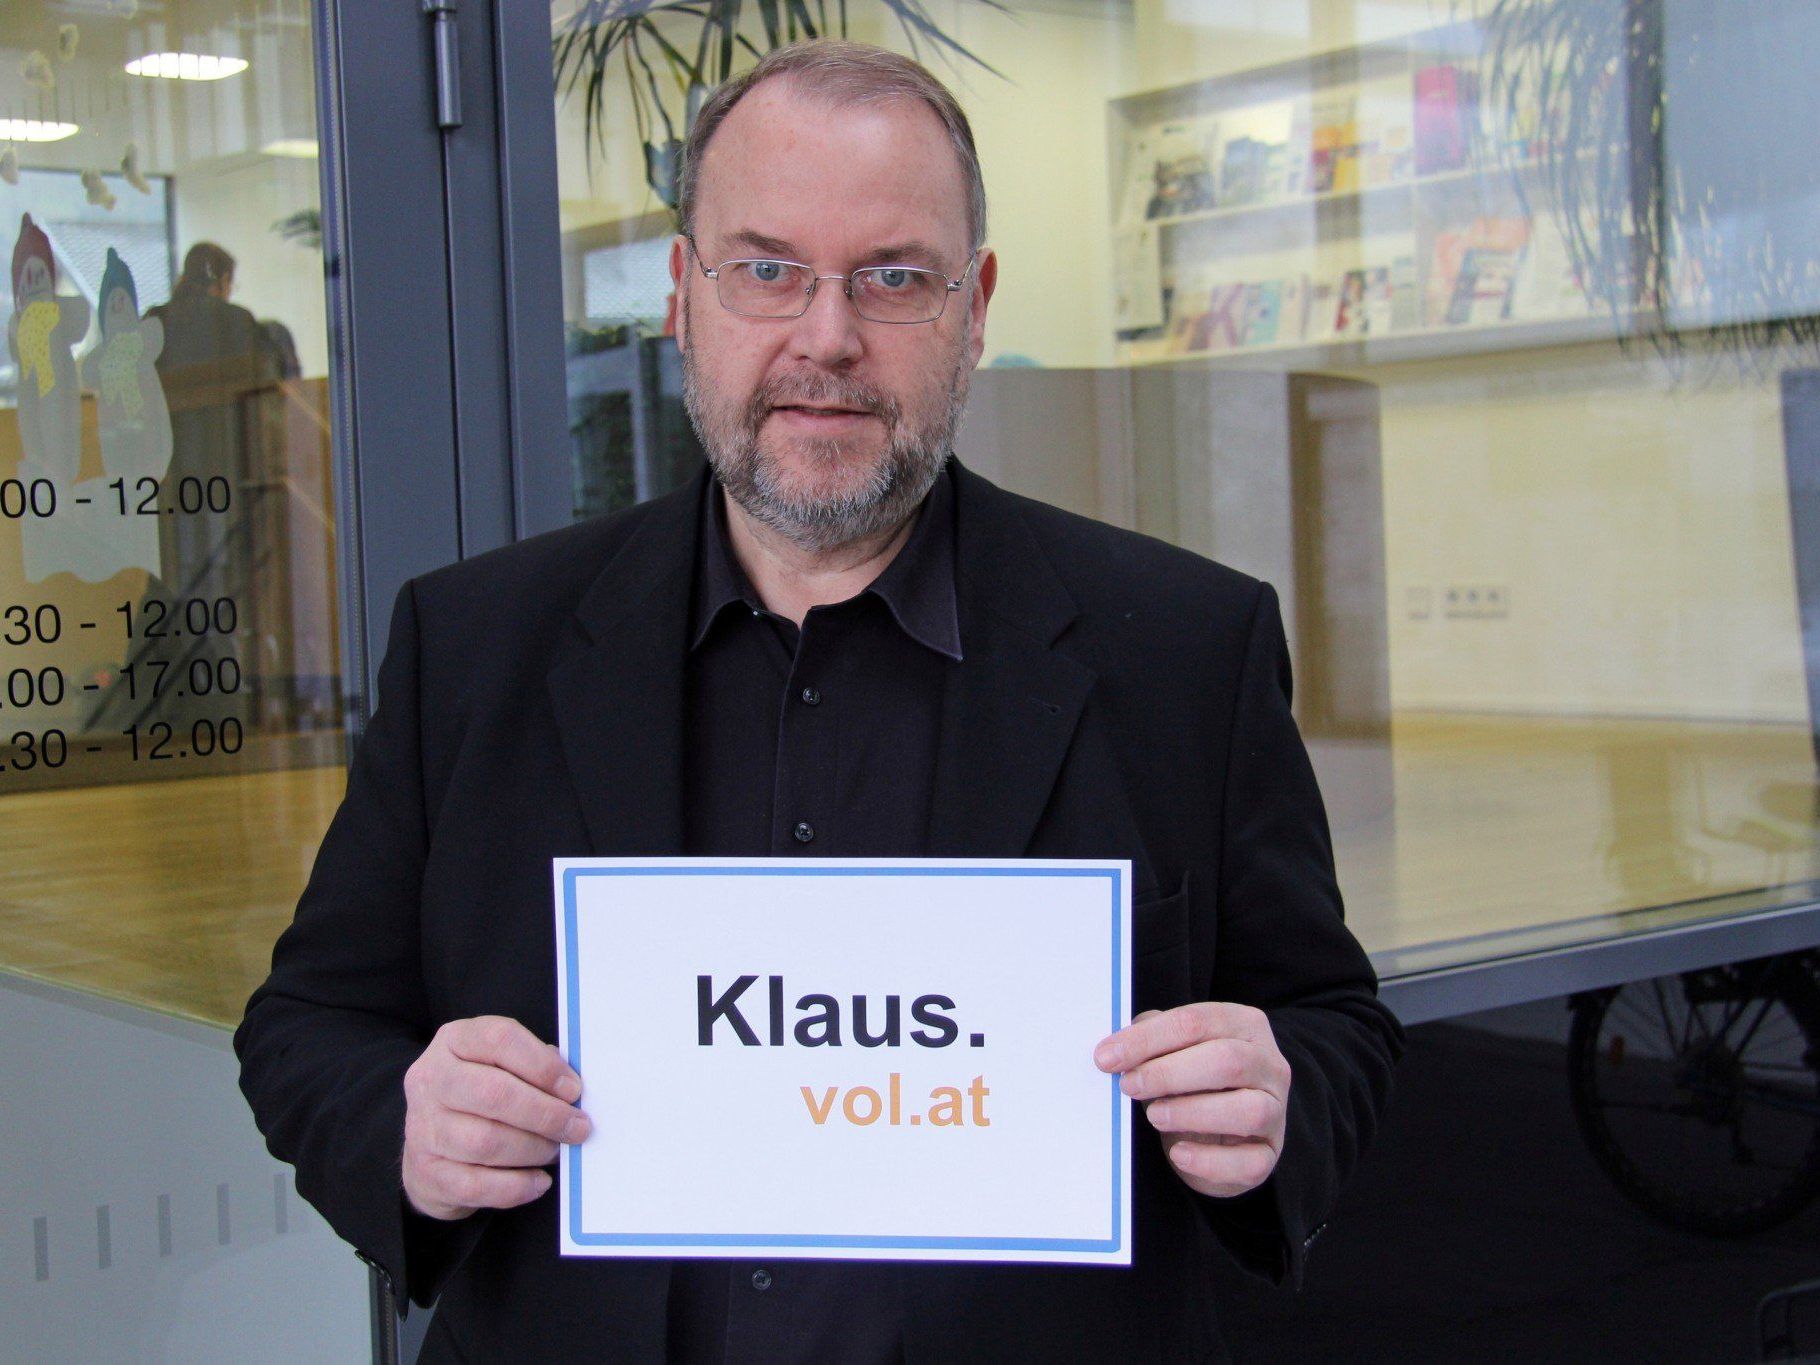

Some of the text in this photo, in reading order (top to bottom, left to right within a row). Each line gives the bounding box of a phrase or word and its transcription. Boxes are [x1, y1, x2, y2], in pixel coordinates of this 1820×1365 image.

[109, 476, 231, 516] 12.00
[116, 597, 238, 638] 12.00
[120, 656, 241, 700] 17.00
[122, 716, 243, 761] 12.00
[697, 975, 985, 1047] Klaus.
[799, 1072, 991, 1127] vol.at
